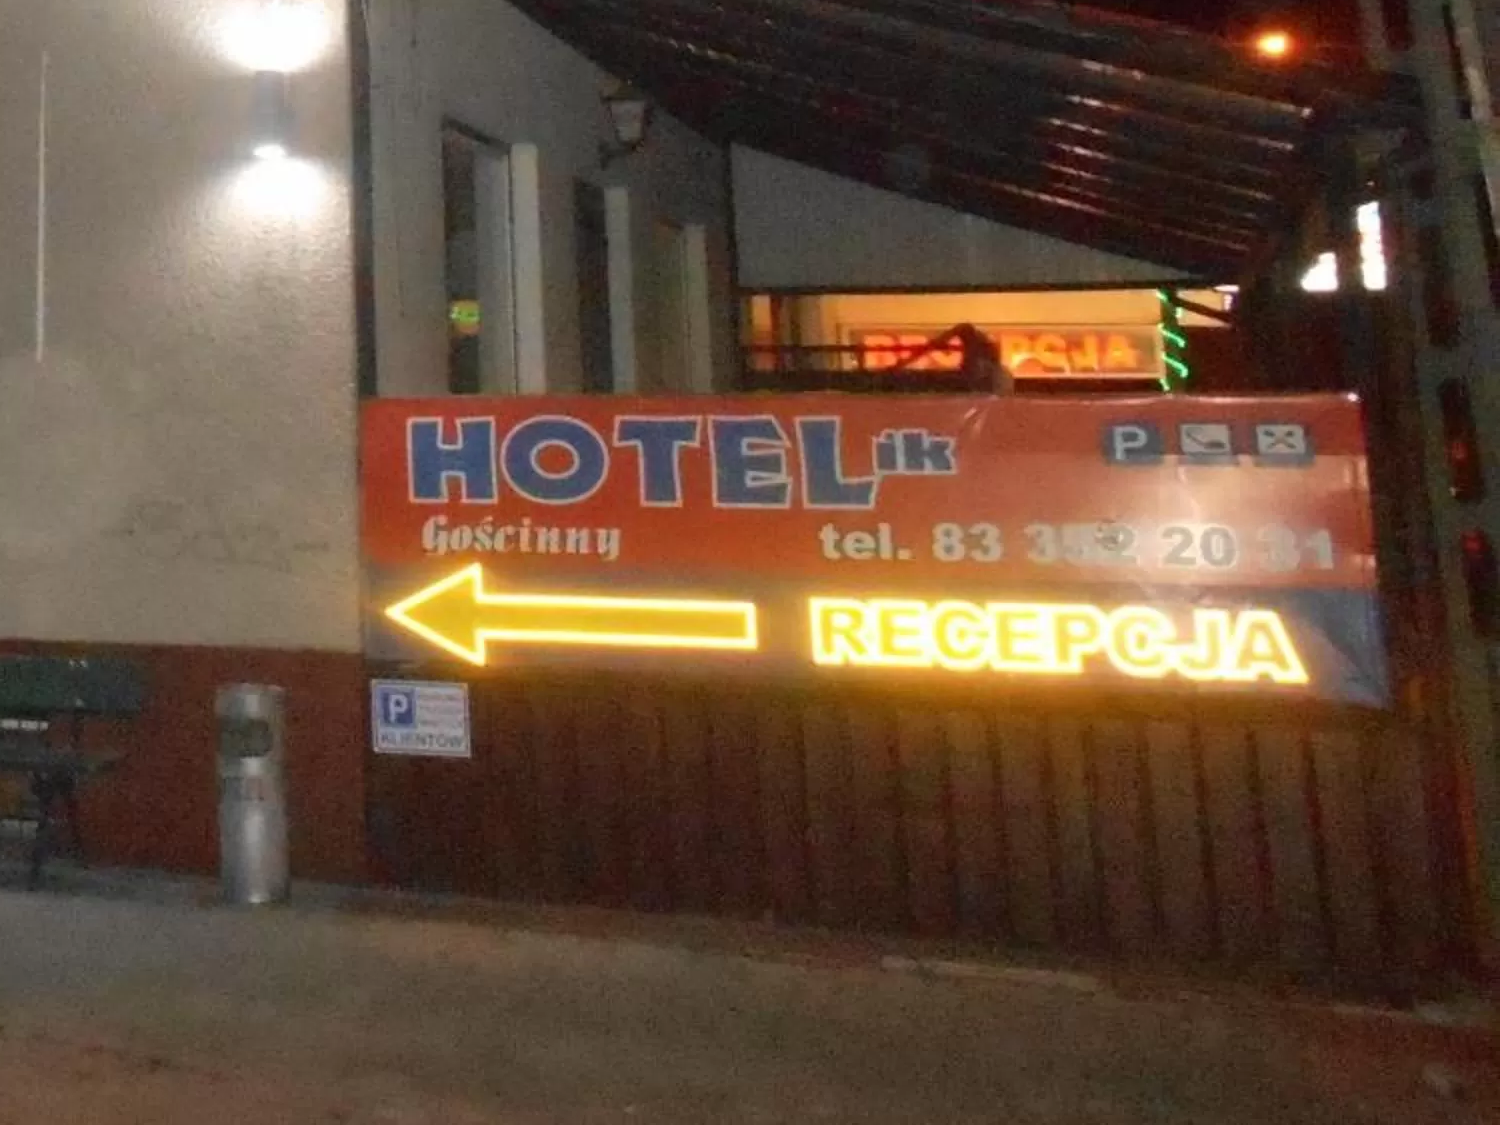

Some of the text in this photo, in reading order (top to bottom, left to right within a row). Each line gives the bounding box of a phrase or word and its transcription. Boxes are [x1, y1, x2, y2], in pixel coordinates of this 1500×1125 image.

[862, 333, 1138, 372] RECPCJA
[421, 514, 621, 562] Gościnny
[818, 522, 915, 562] tel.
[932, 523, 1004, 563] 83
[1160, 523, 1239, 569] 20
[809, 596, 1311, 685] RECEPCJA
